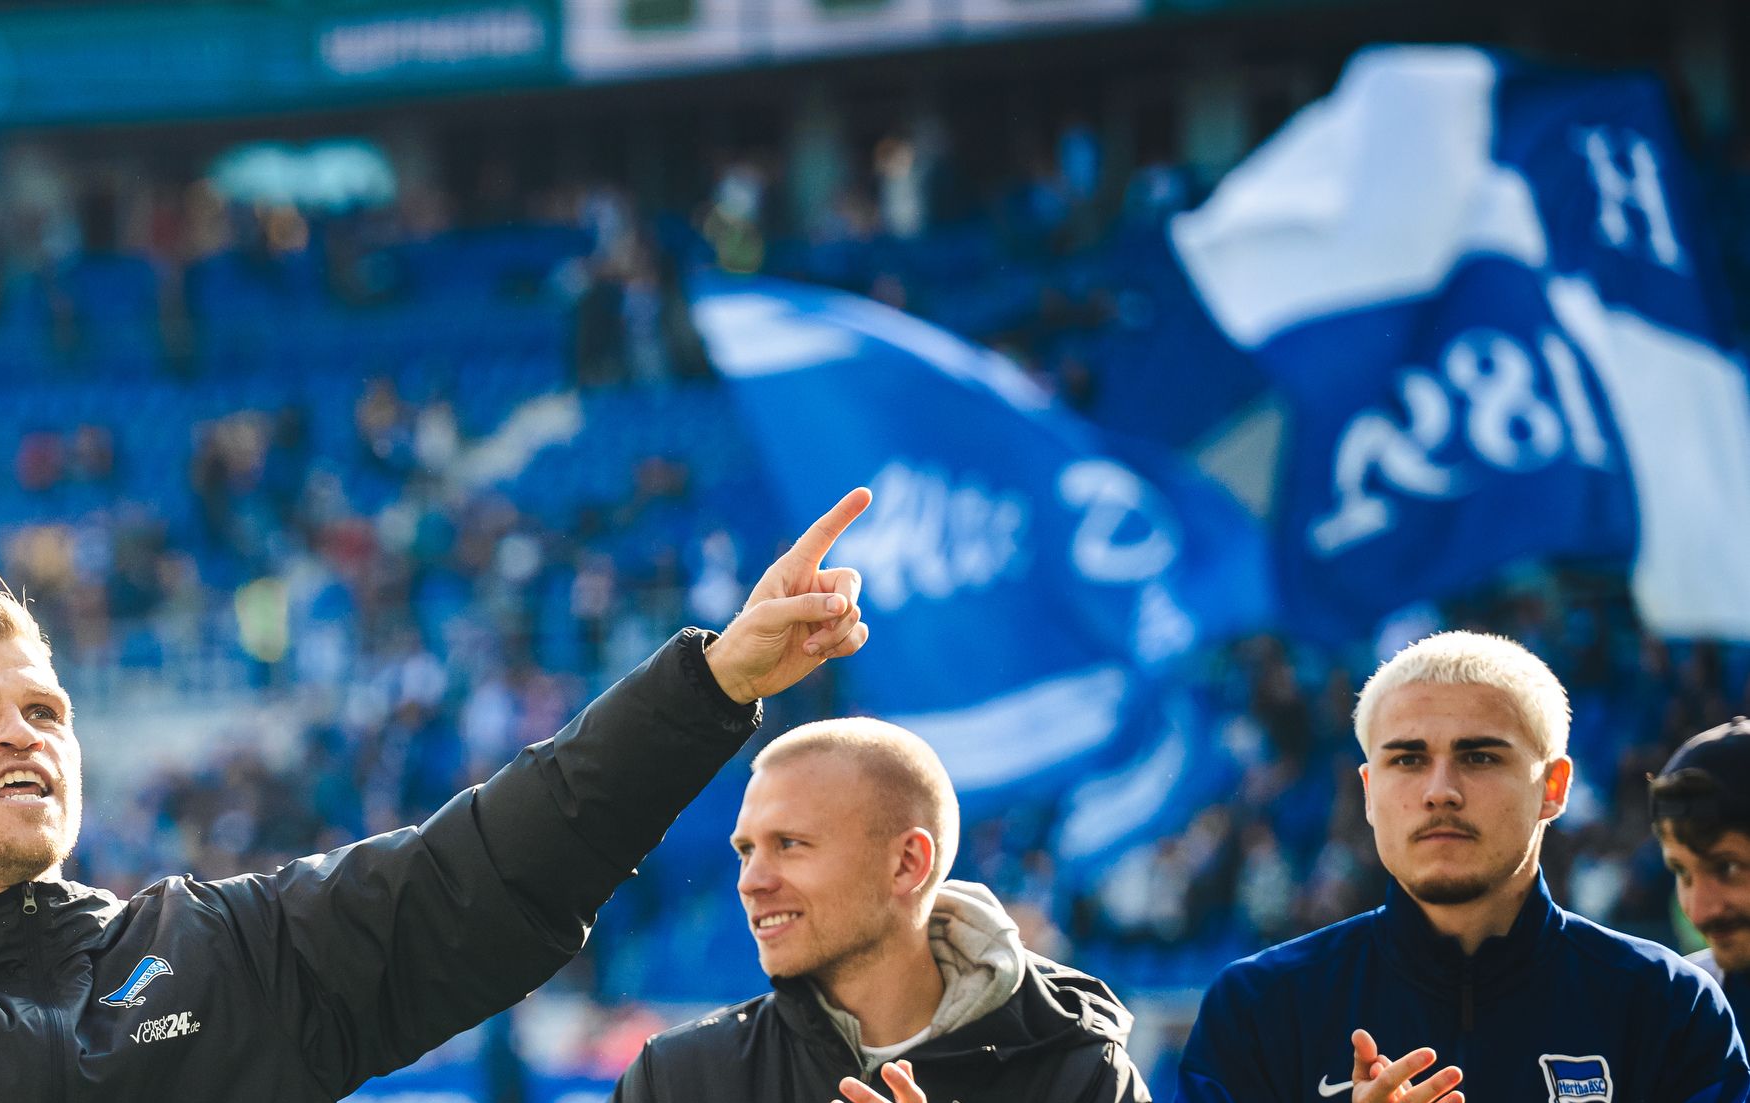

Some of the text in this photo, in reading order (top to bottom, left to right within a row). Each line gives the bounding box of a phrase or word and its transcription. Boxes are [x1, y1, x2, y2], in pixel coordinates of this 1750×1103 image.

[143, 1015, 170, 1031] check
[166, 1011, 191, 1039] 24
[142, 1027, 167, 1043] CARS
[1558, 1079, 1606, 1095] Hertha BSC
